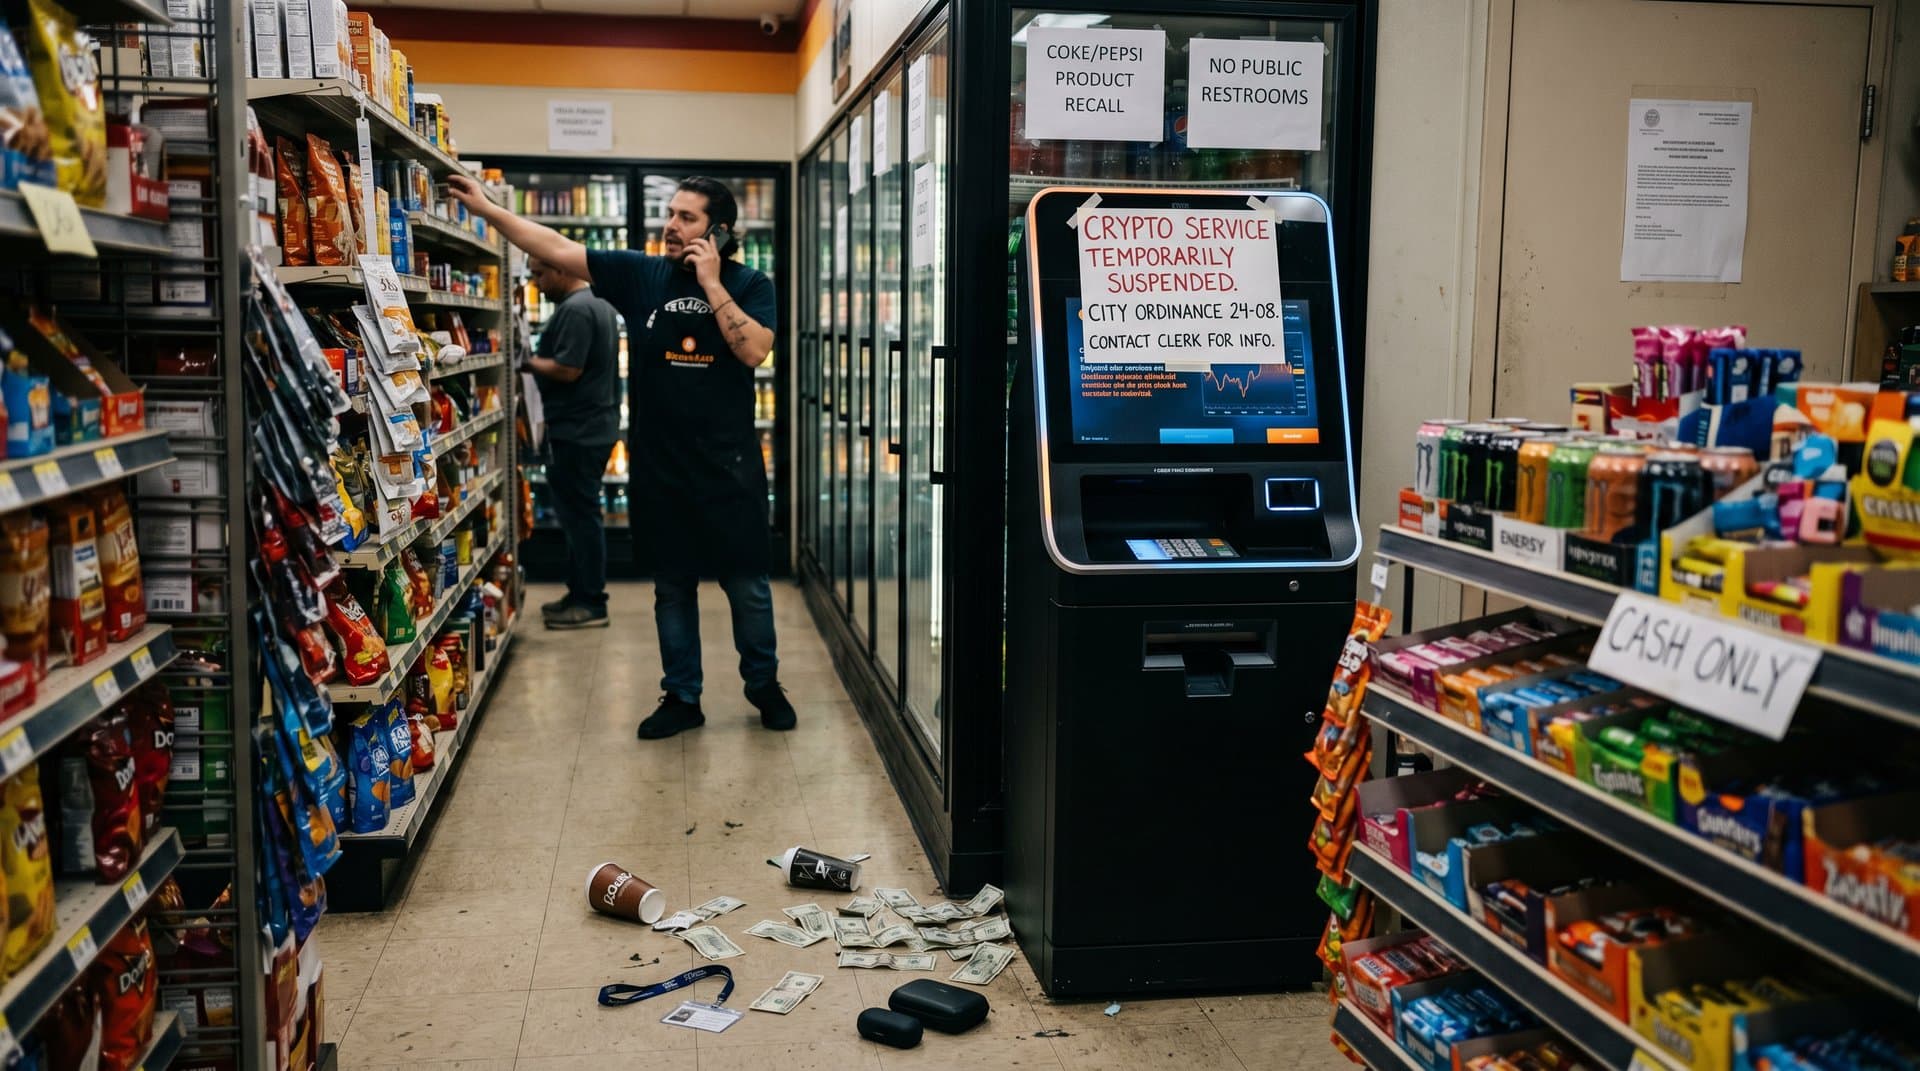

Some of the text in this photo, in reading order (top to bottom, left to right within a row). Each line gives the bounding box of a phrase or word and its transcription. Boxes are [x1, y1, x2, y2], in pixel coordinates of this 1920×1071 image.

[1047, 44, 1143, 62] COKE/PEPSI
[1209, 58, 1303, 77] NO PUBLIC
[1055, 71, 1135, 88] PRODUCT
[1065, 97, 1125, 113] RECALL
[1201, 86, 1309, 105] RESTROOMS
[1084, 215, 1270, 241] CRYPTO SERVICE
[1085, 246, 1235, 268] TEMPORARILY
[1107, 272, 1238, 293] SUSPENDED.
[1088, 302, 1280, 322] CITY ORDINANCE 24-08.
[1089, 334, 1151, 350] CONTACT
[1157, 333, 1202, 348] CLERK
[1208, 332, 1233, 348] FOR
[1239, 333, 1276, 348] INFO.
[1607, 606, 1795, 711] CASH ONLY
